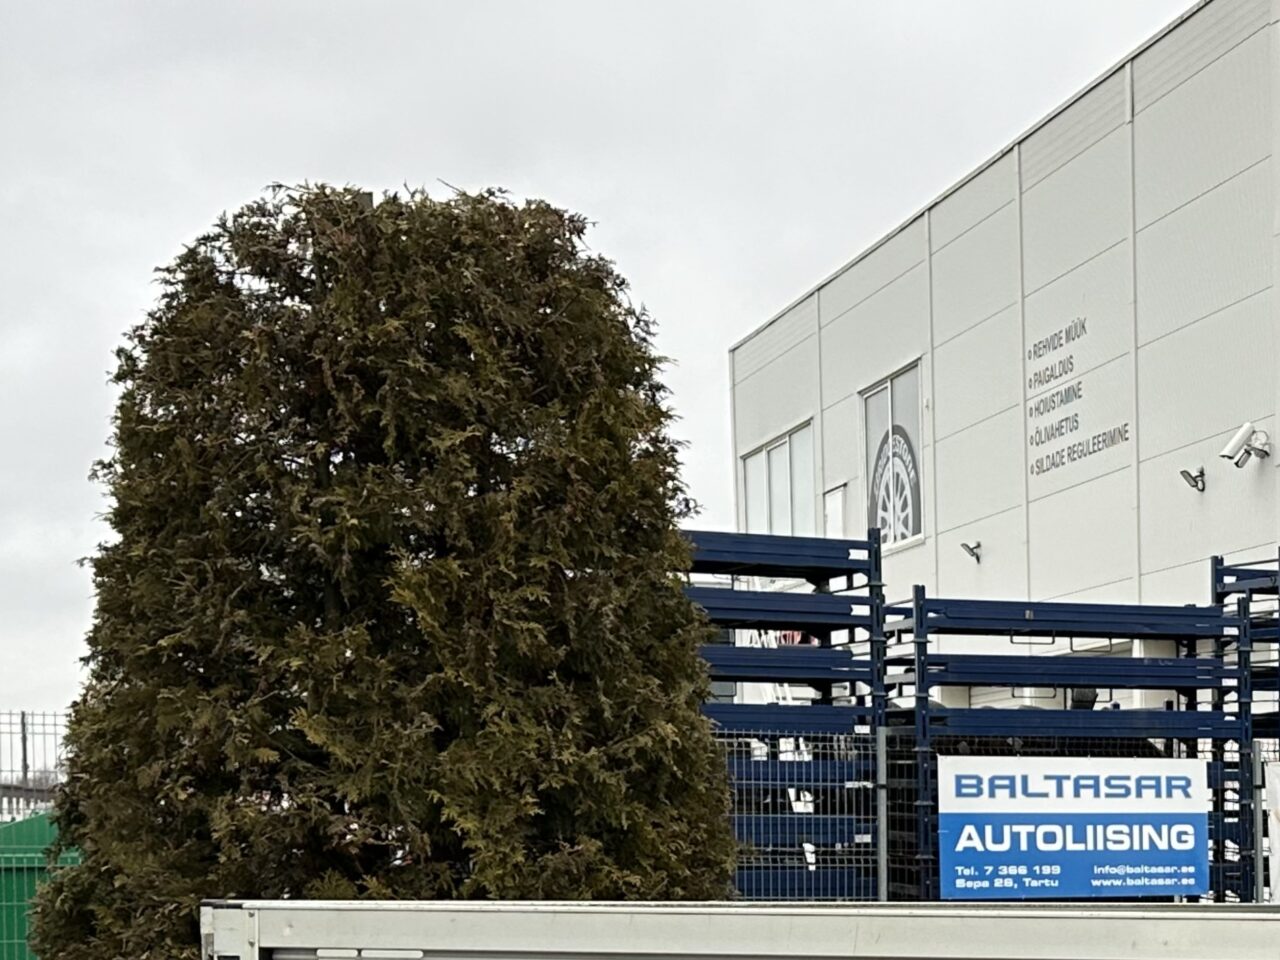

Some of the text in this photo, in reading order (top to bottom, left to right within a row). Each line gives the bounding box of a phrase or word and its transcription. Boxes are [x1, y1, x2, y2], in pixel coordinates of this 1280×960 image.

[1032, 317, 1088, 360] REHVIDE MÜÜK
[1033, 355, 1074, 389] PAIGALDUS
[1035, 423, 1130, 476] SILDADE REGULEERIMINE
[954, 774, 1193, 799] BALTASAR
[955, 824, 1196, 852] AUTOLIISING
[955, 865, 1061, 876] Tel. 7 366 199
[1091, 877, 1196, 886] www.baltasar.ee
[1093, 865, 1196, 875] info@baltasar.ee
[955, 879, 989, 890] Sepa
[1023, 877, 1059, 887] Tartu
